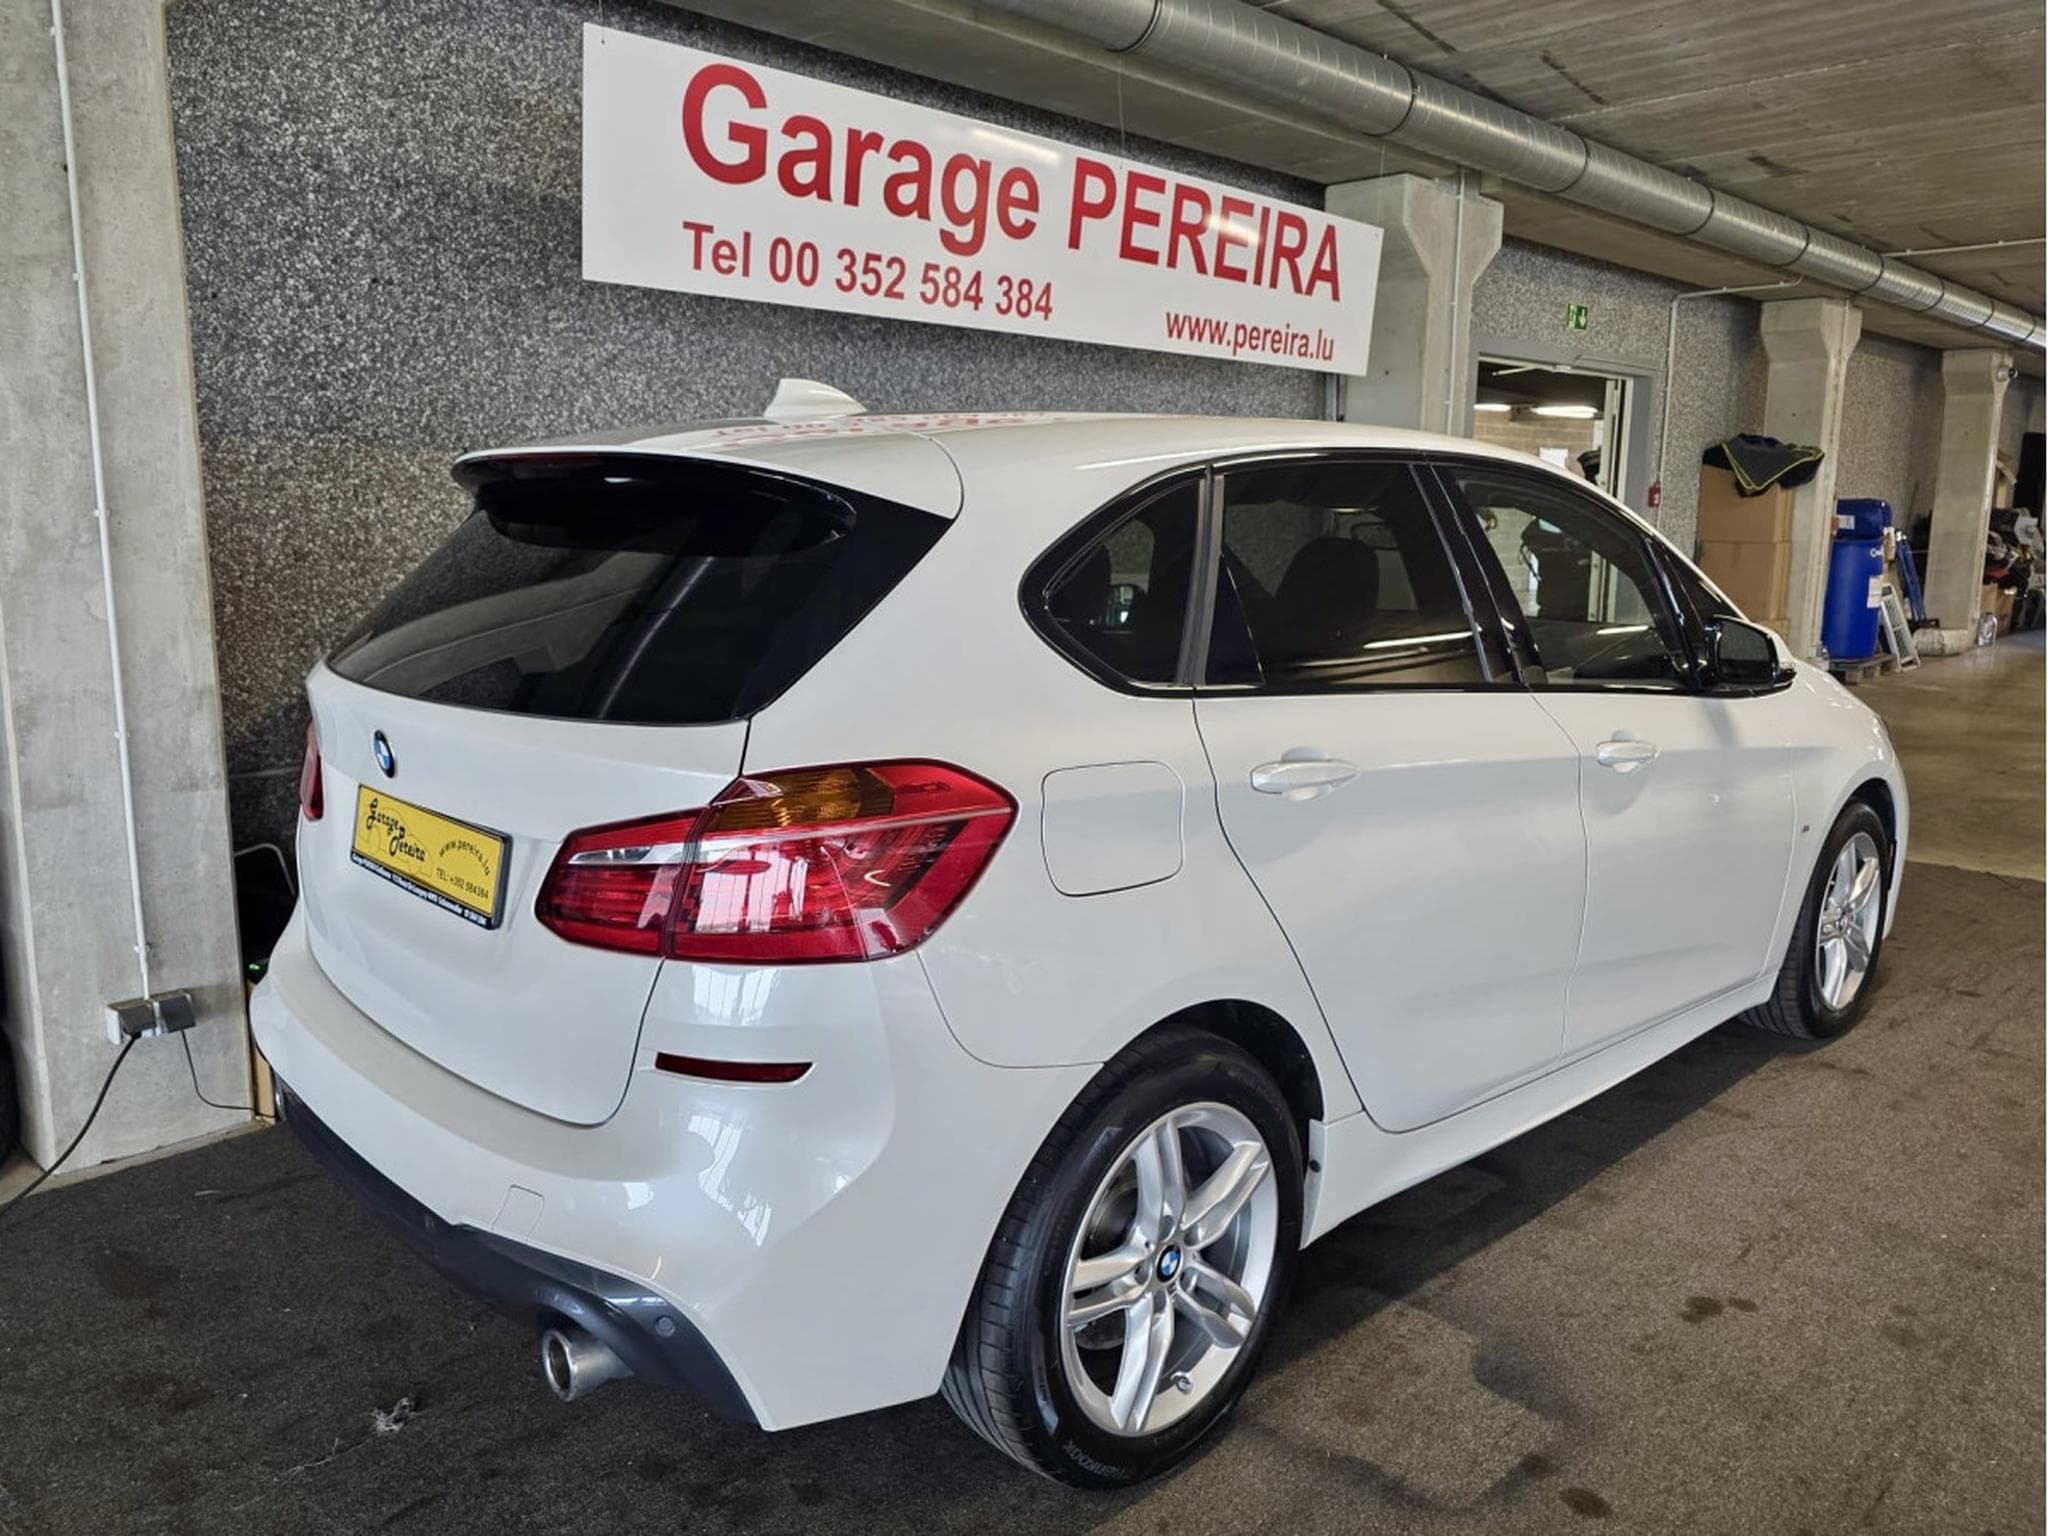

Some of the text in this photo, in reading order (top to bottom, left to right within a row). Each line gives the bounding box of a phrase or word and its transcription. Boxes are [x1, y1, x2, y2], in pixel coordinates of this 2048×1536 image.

[682, 63, 1341, 302] Garage PEREIRA
[683, 221, 1053, 320] Tel 00 352 584 384
[1165, 311, 1335, 362] www.pereira.lu
[366, 798, 400, 836] Garage
[389, 826, 426, 862] Pereira
[439, 840, 490, 876] www.pereira.lu
